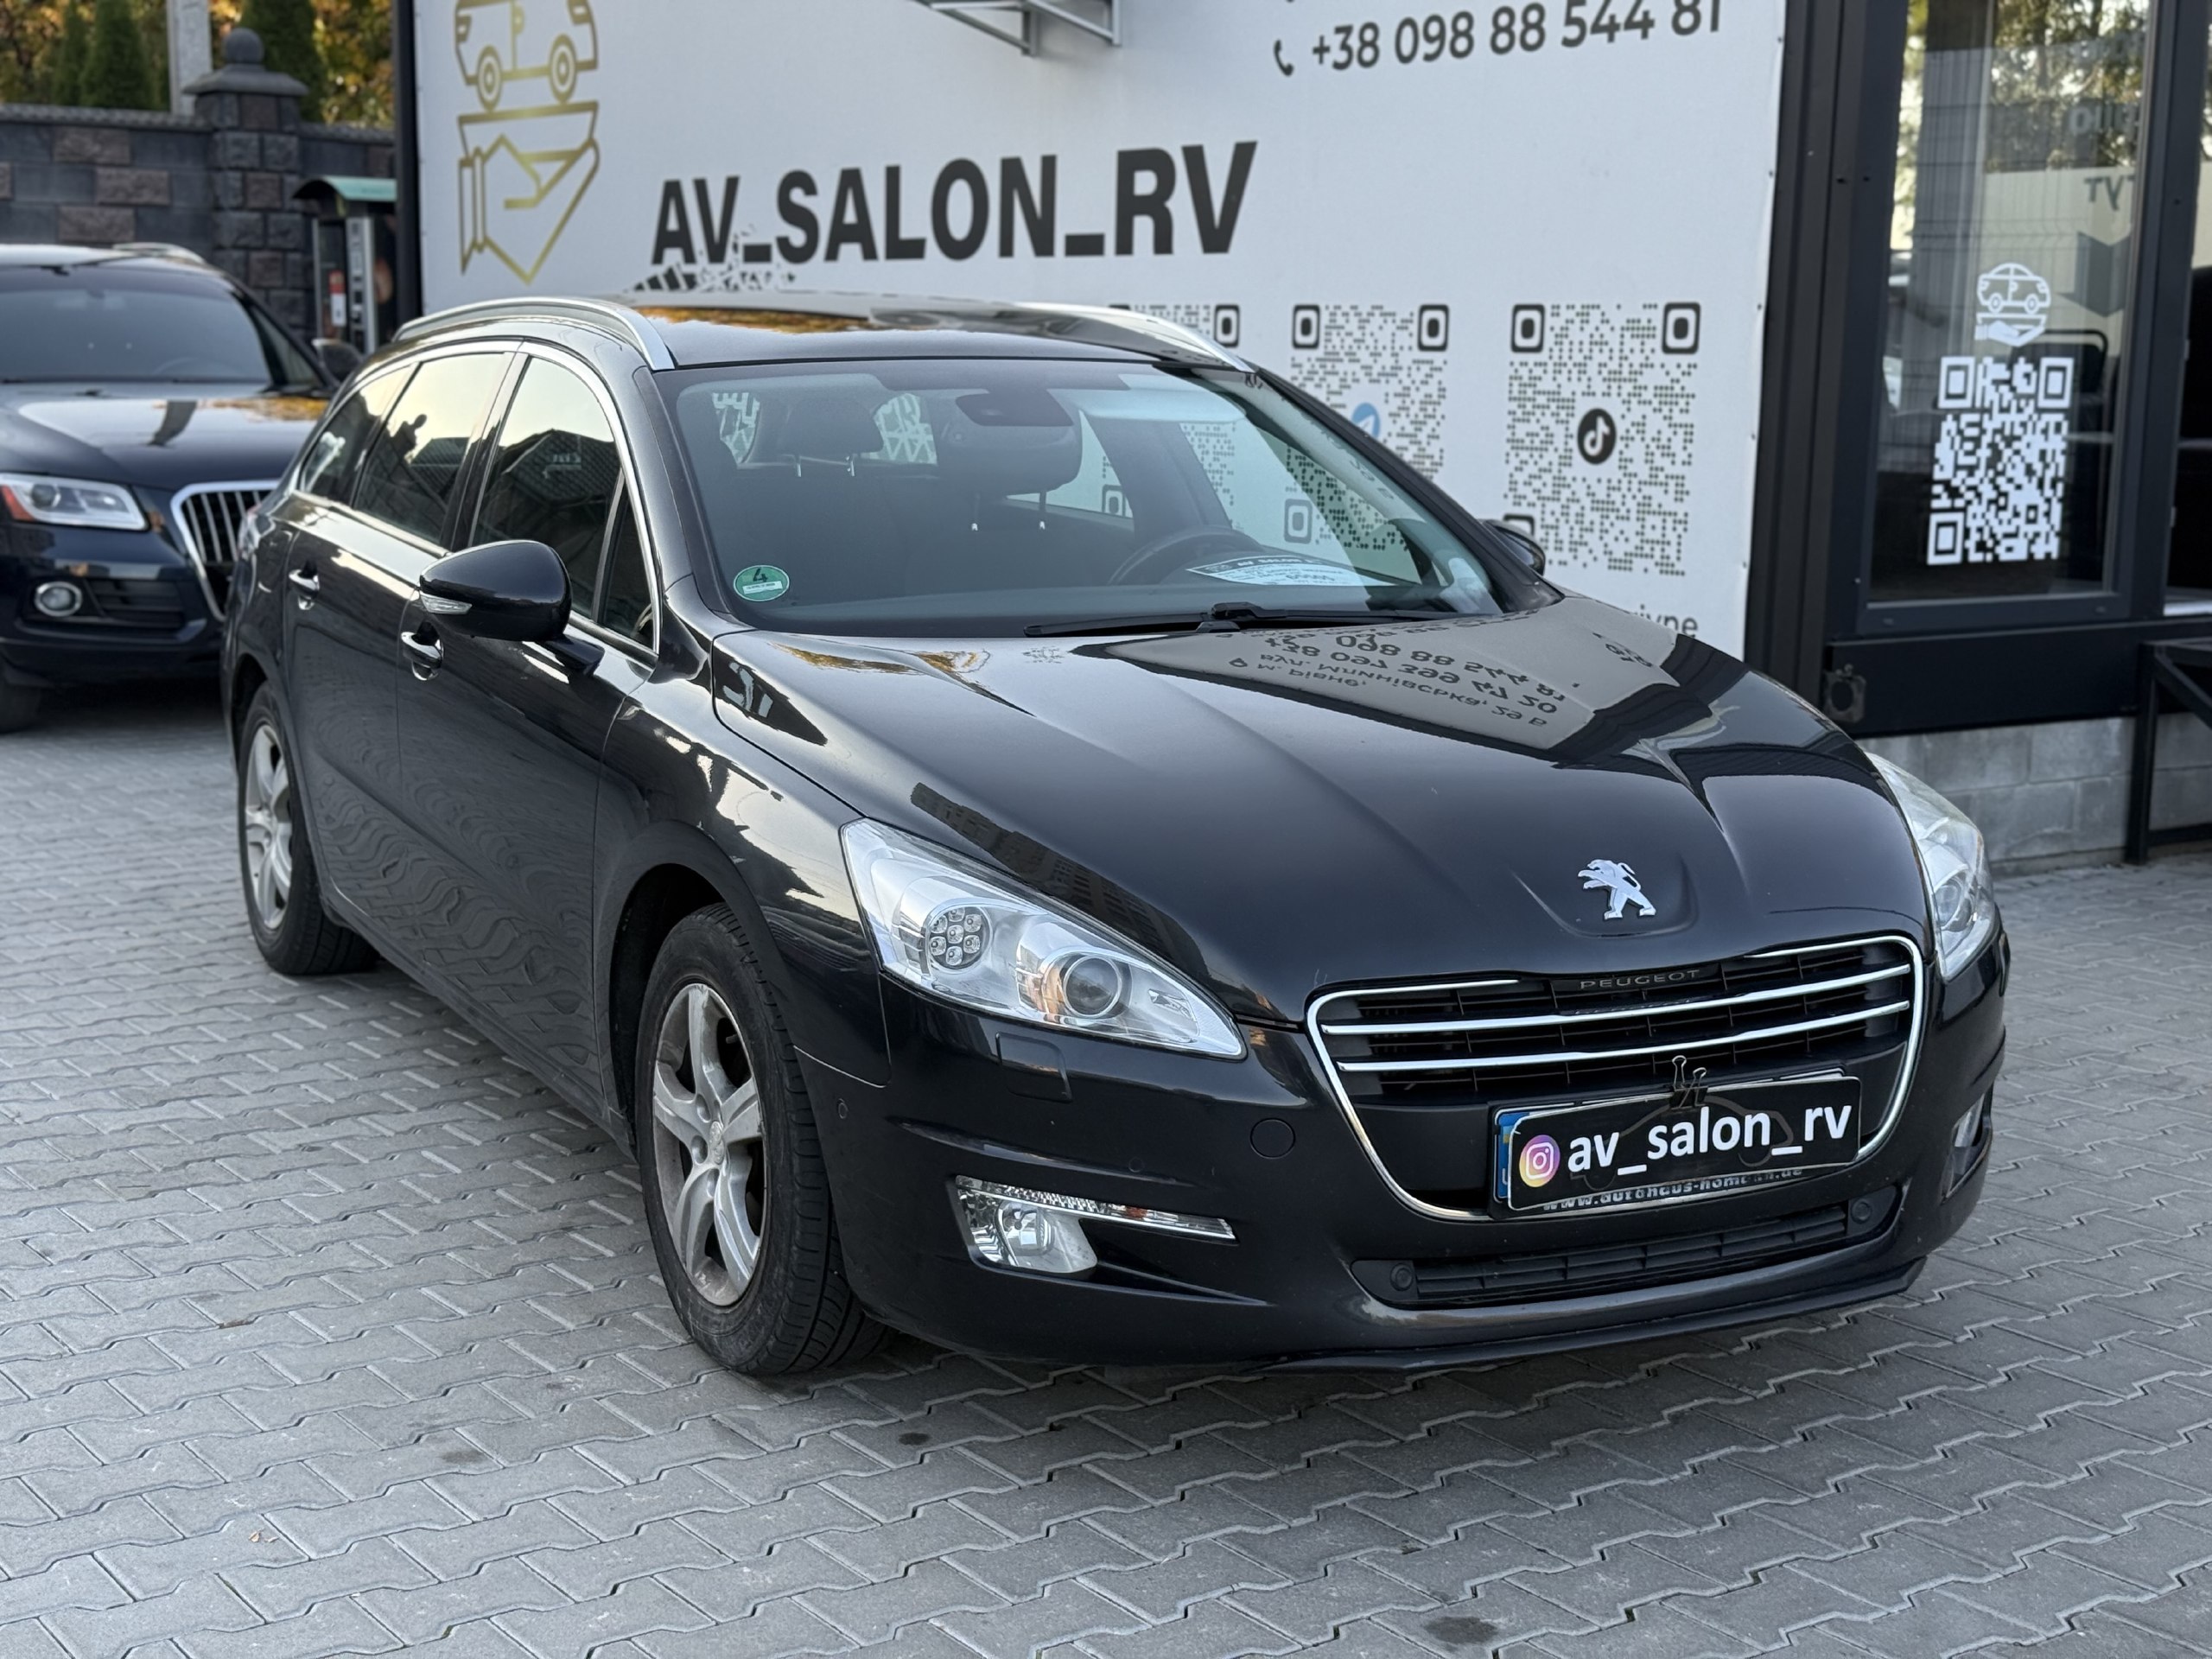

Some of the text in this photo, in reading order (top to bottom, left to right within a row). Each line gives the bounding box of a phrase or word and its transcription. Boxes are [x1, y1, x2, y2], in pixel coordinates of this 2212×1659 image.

[1313, 22, 1381, 71] +38
[1395, 11, 1475, 64] 098
[1490, 3, 1547, 55] 88
[1560, 0, 1656, 48] 544
[651, 141, 1259, 266] AV_SALON_RV
[753, 568, 769, 582] 4
[1580, 969, 1700, 989] PEUGEOT
[1567, 1105, 1853, 1176] av_salon_rv
